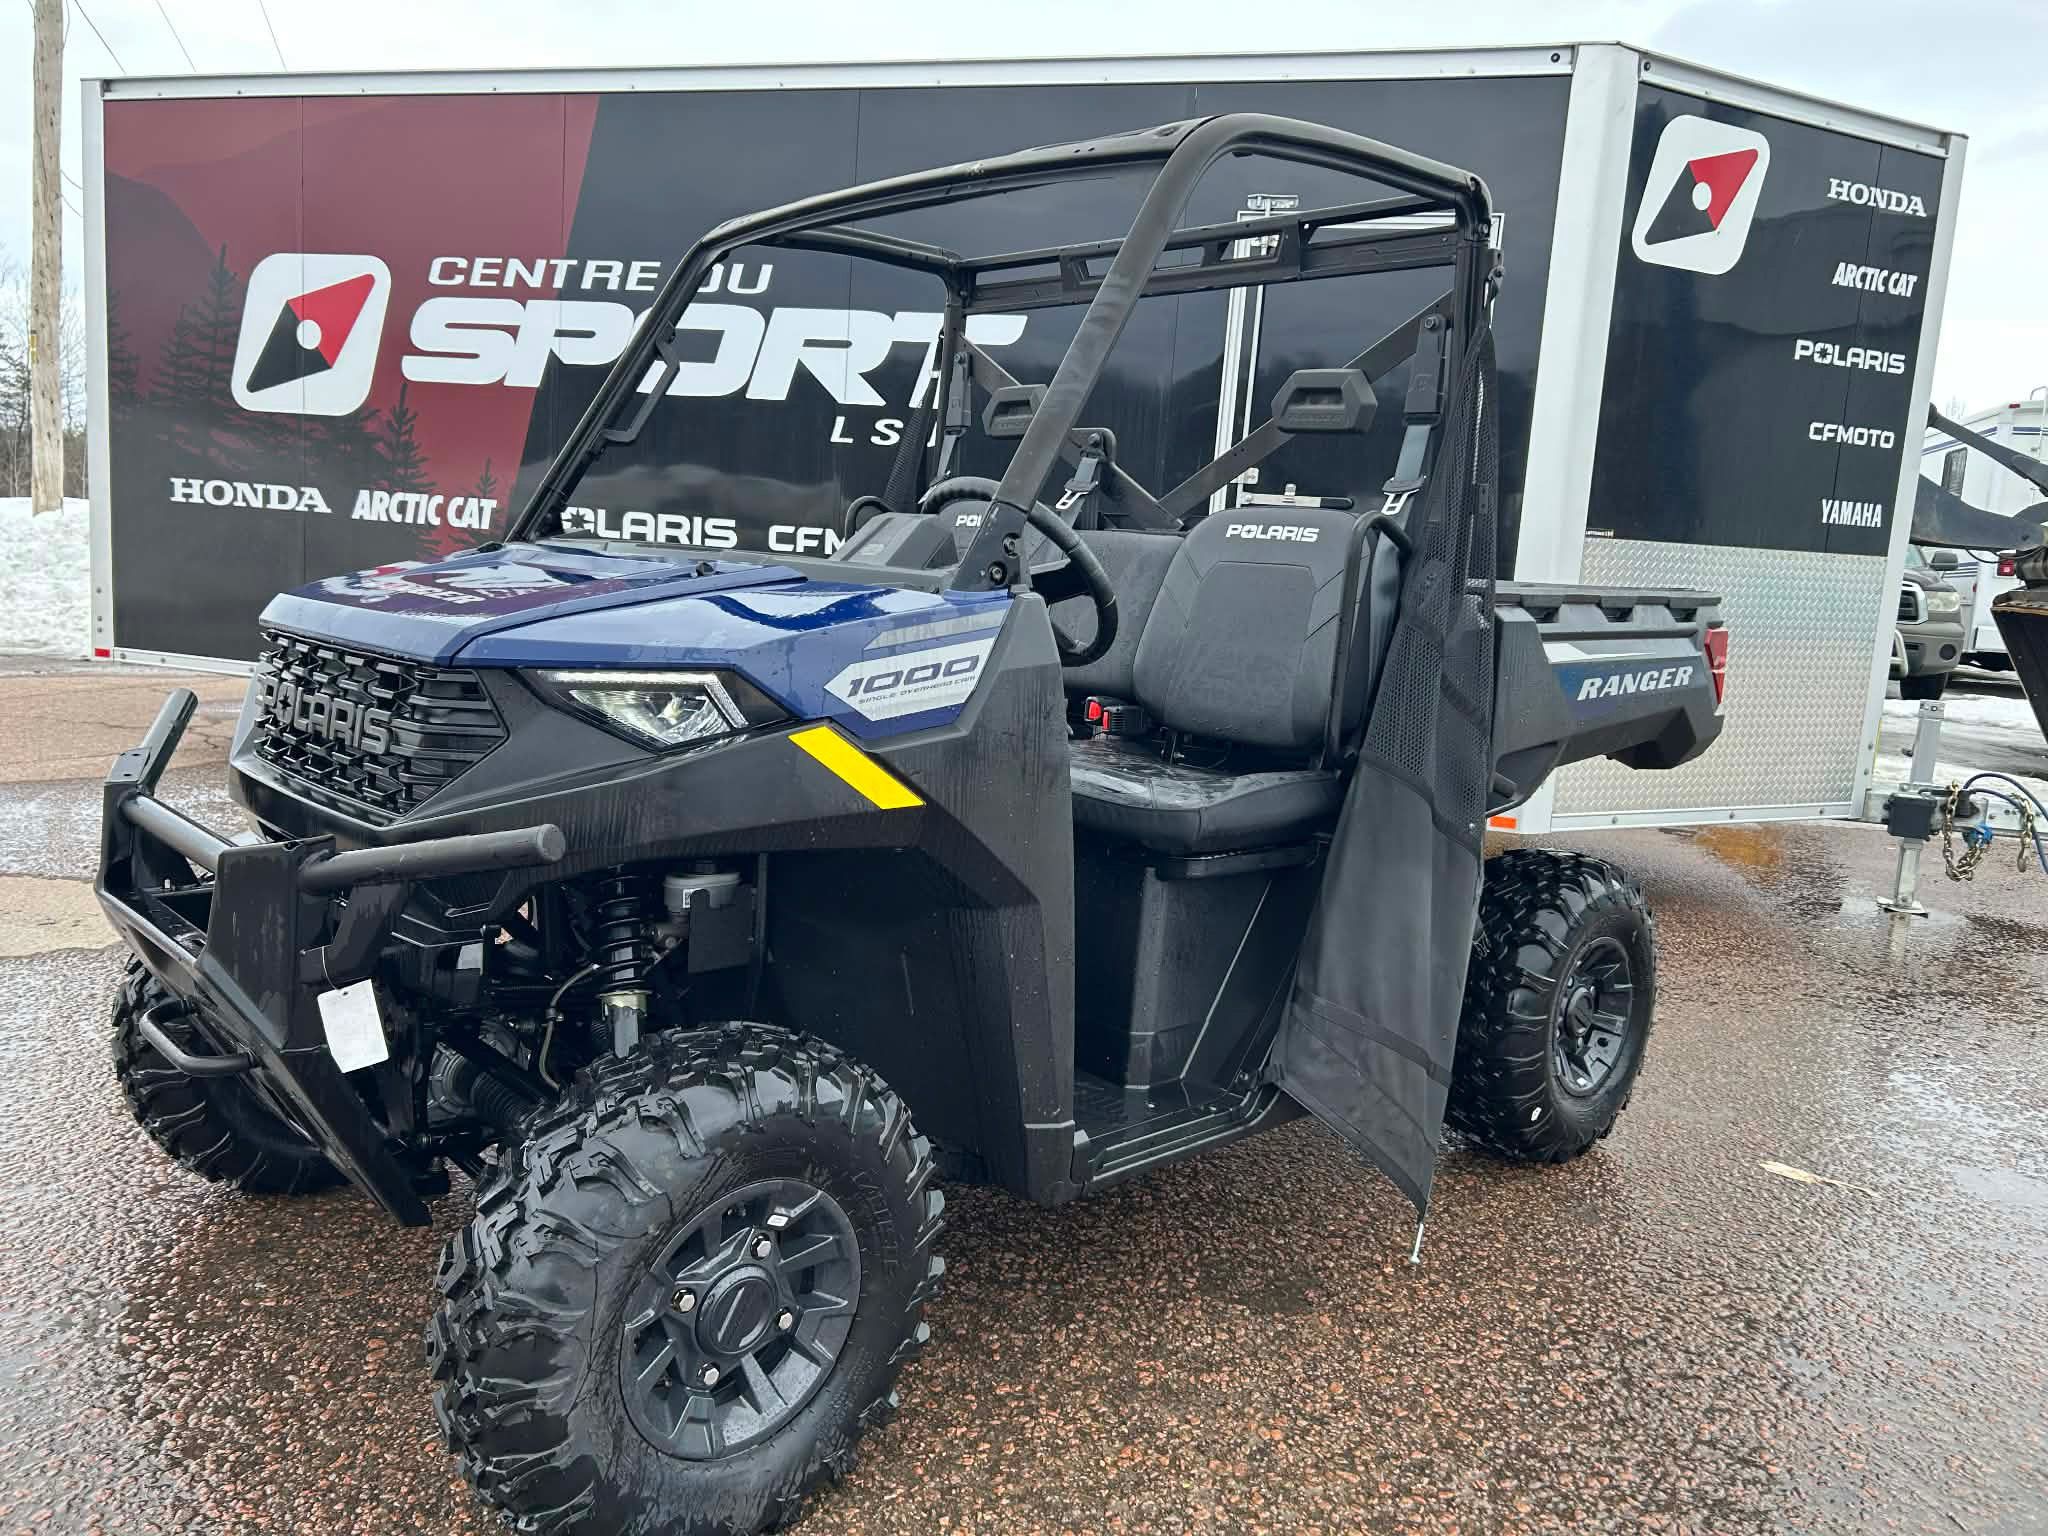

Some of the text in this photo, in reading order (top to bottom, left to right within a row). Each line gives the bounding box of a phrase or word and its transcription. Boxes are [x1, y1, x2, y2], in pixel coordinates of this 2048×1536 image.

[1827, 178, 1927, 217] HONDA
[428, 256, 661, 291] CENTRE
[1831, 262, 1918, 297] ARCTIC CAT
[401, 297, 1028, 409] SPORT
[1794, 339, 1906, 374] POLARIS
[1808, 421, 1895, 449] CFMOTO
[169, 477, 332, 513] HONDA
[351, 489, 498, 530] ARCTIC CAT
[560, 506, 738, 549] OLARIS
[1821, 498, 1883, 528] YAMAHA
[1225, 524, 1320, 542] POLARIS
[847, 655, 980, 698] 1000
[1577, 665, 1694, 700] RANGER
[255, 673, 392, 755] POLARIS
